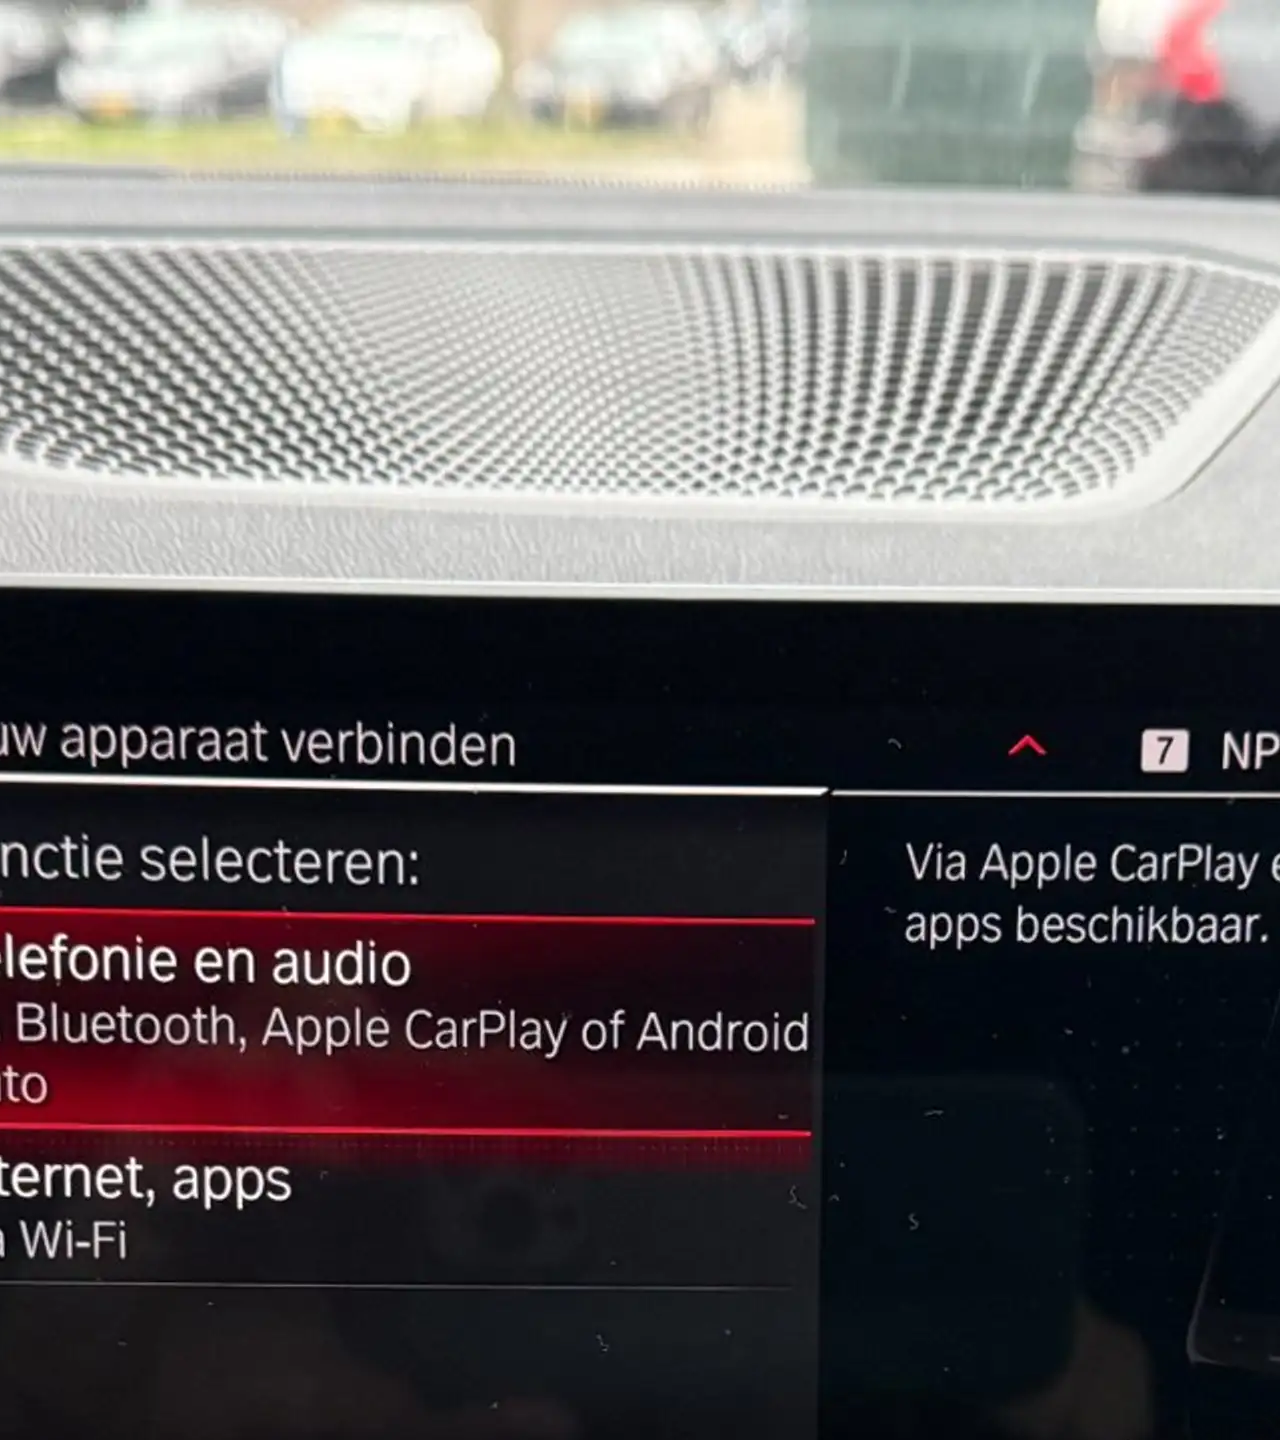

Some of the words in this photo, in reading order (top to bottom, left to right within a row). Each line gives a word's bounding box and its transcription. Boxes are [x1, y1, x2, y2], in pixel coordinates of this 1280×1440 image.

[60, 721, 268, 769] apparaat
[281, 721, 515, 767] verbinden
[1157, 736, 1174, 765] 7
[140, 836, 418, 885] selecteren:
[906, 842, 966, 881] Via
[979, 843, 1097, 890] Apple
[1110, 843, 1260, 890] CarPlay
[905, 912, 1002, 950] apps
[1016, 905, 1268, 944] beschikbaar.
[194, 946, 255, 984] en
[272, 939, 411, 987] audio
[16, 1001, 247, 1054] Bluetooth,
[261, 1007, 390, 1056] Apple
[405, 1009, 568, 1059] CarPlay
[581, 1009, 625, 1051] of
[636, 1011, 808, 1052] Android
[173, 1164, 292, 1210] apps
[19, 1219, 126, 1259] Wi-Fi
